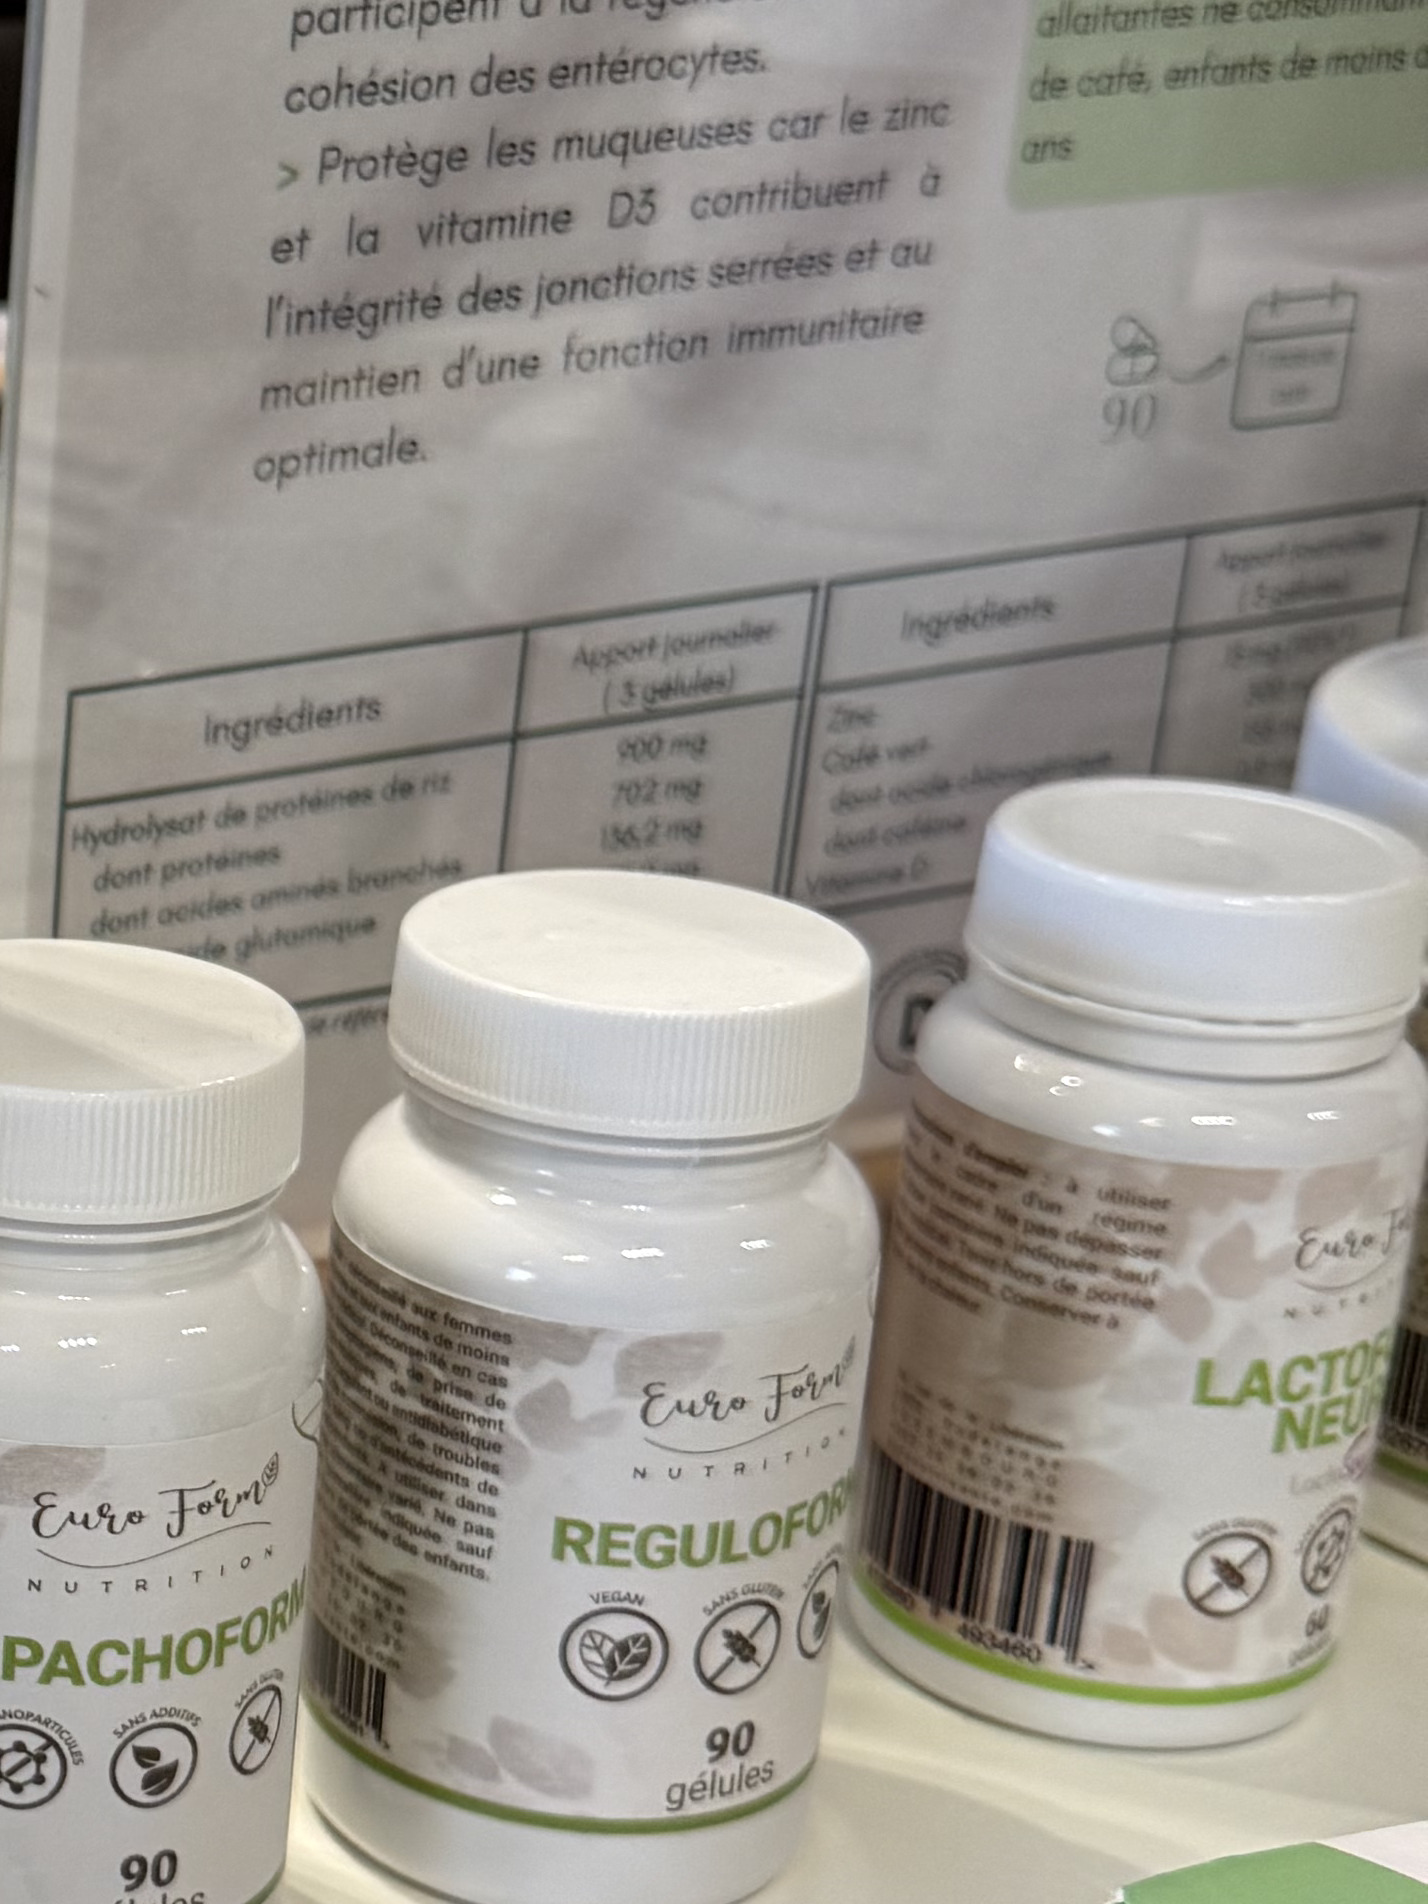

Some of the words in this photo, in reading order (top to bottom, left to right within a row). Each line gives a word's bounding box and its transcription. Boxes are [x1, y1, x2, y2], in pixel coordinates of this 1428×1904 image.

[706, 1721, 755, 1763] 90
[665, 1759, 774, 1813] gélules
[120, 1850, 178, 1892] 90
